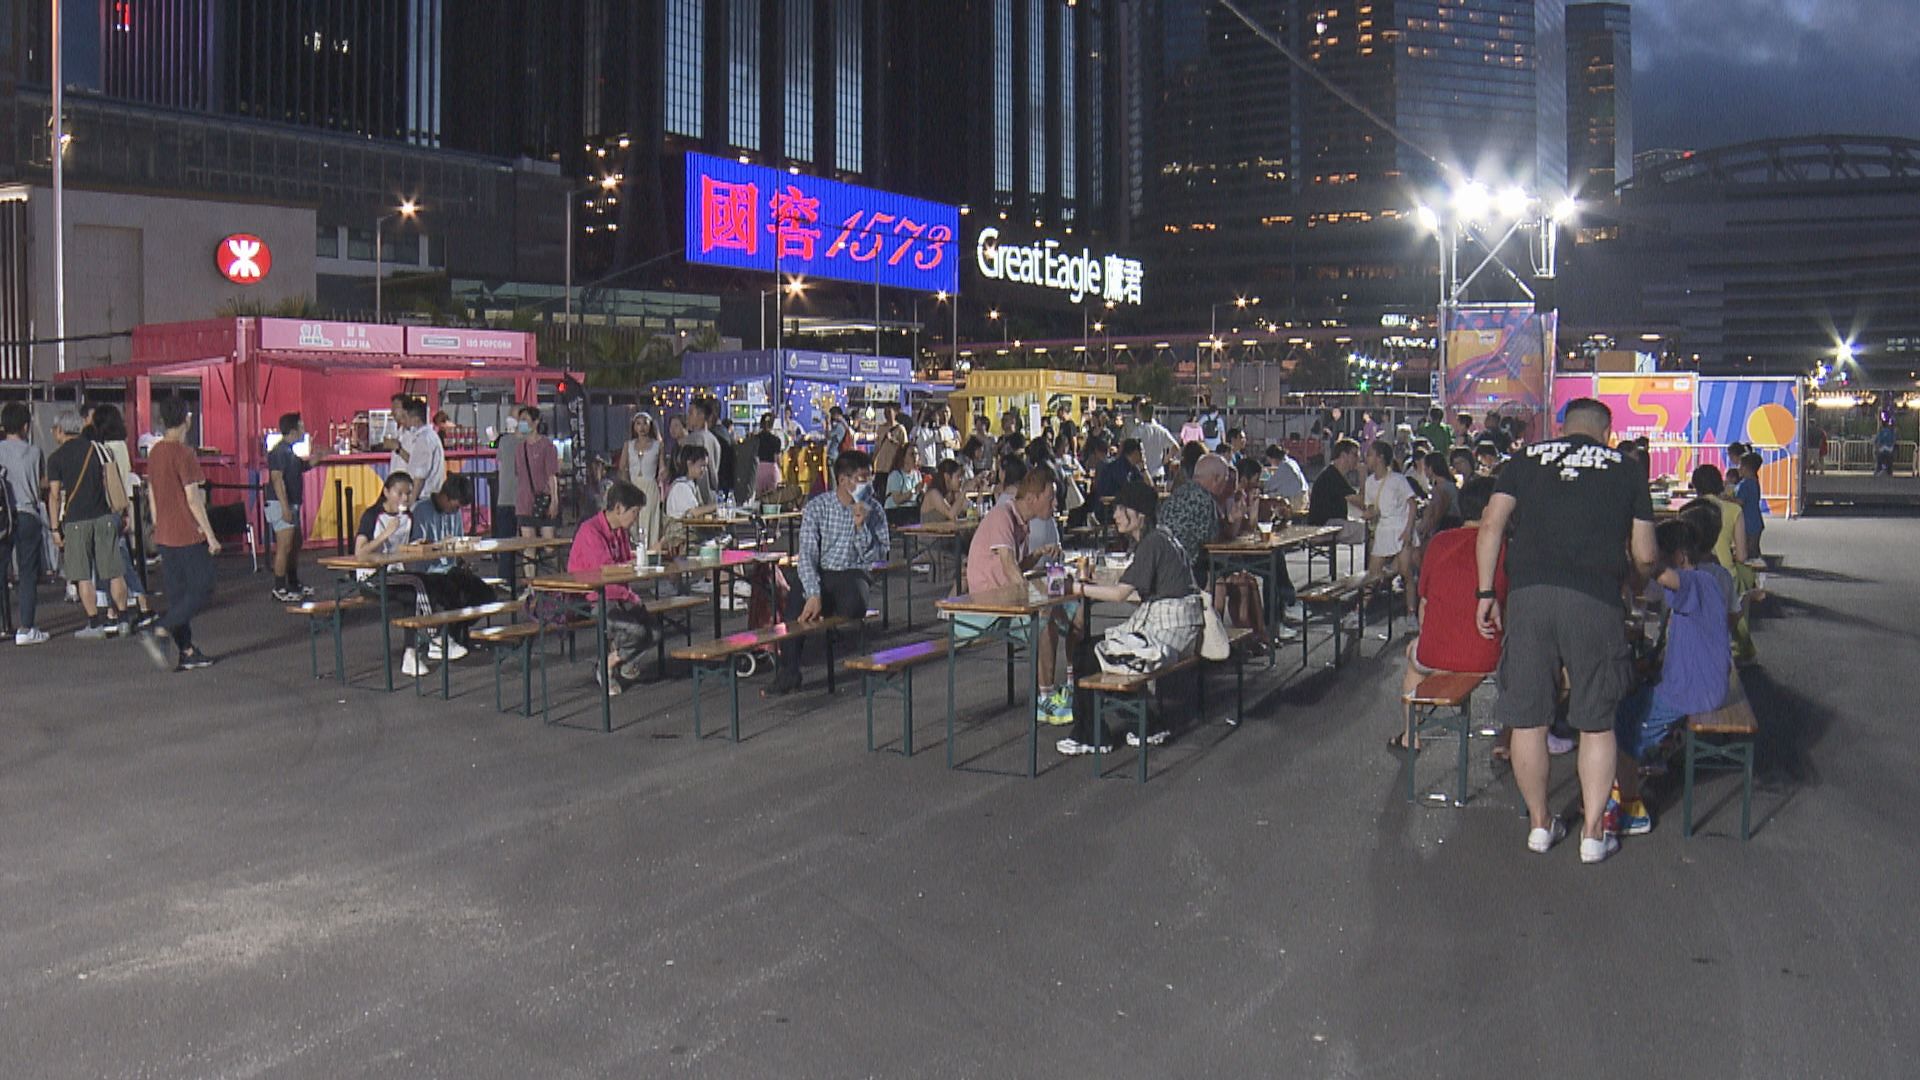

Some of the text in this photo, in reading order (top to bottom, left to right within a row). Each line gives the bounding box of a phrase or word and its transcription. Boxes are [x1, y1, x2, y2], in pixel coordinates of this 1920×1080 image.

[702, 174, 952, 270] 國窖 1573
[977, 226, 1044, 285] Great
[1044, 239, 1101, 303] Eagle
